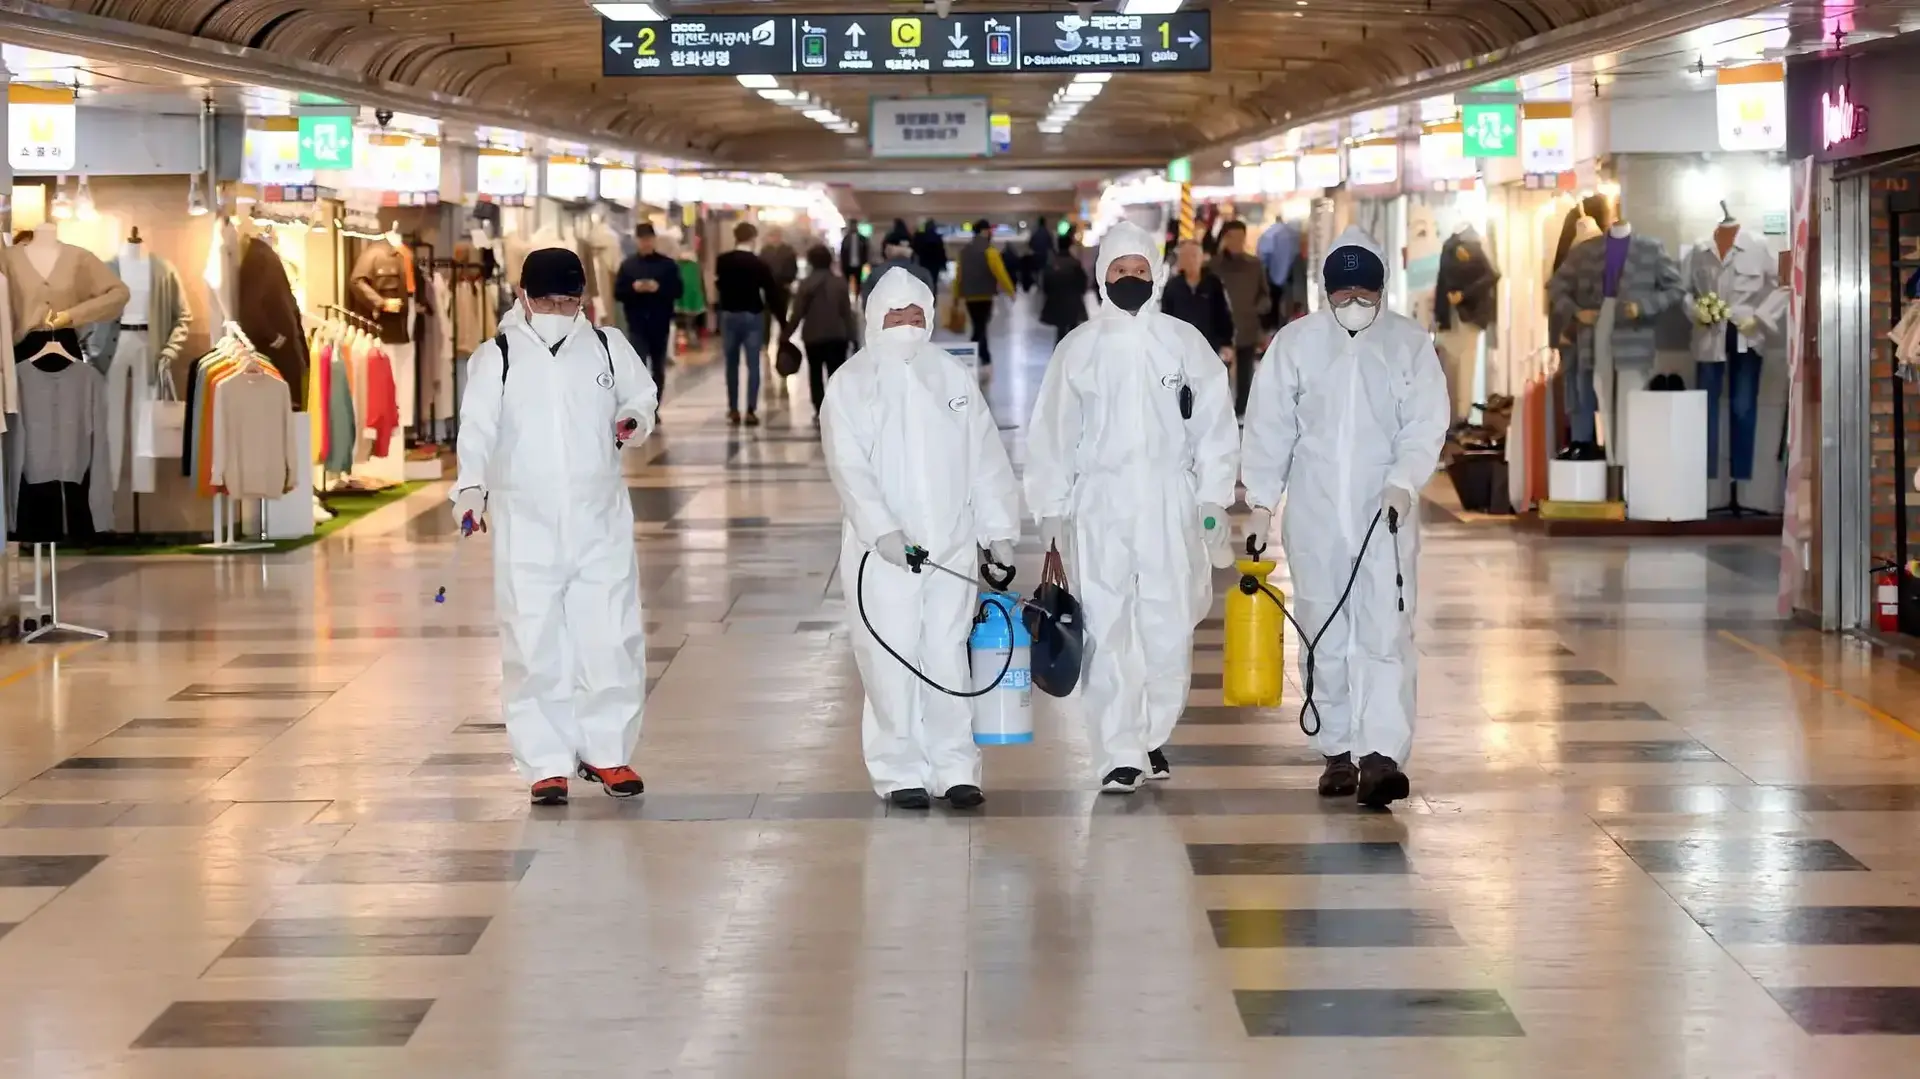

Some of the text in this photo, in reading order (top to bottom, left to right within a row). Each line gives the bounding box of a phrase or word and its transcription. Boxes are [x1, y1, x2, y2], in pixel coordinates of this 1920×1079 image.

[637, 27, 656, 56] 2
[671, 32, 751, 46] 대전도시공사
[898, 23, 914, 43] C
[1158, 21, 1169, 48] 1
[633, 57, 660, 69] gate
[670, 50, 730, 67] 한화생명
[1151, 50, 1178, 62] gate
[1343, 252, 1359, 271] B
